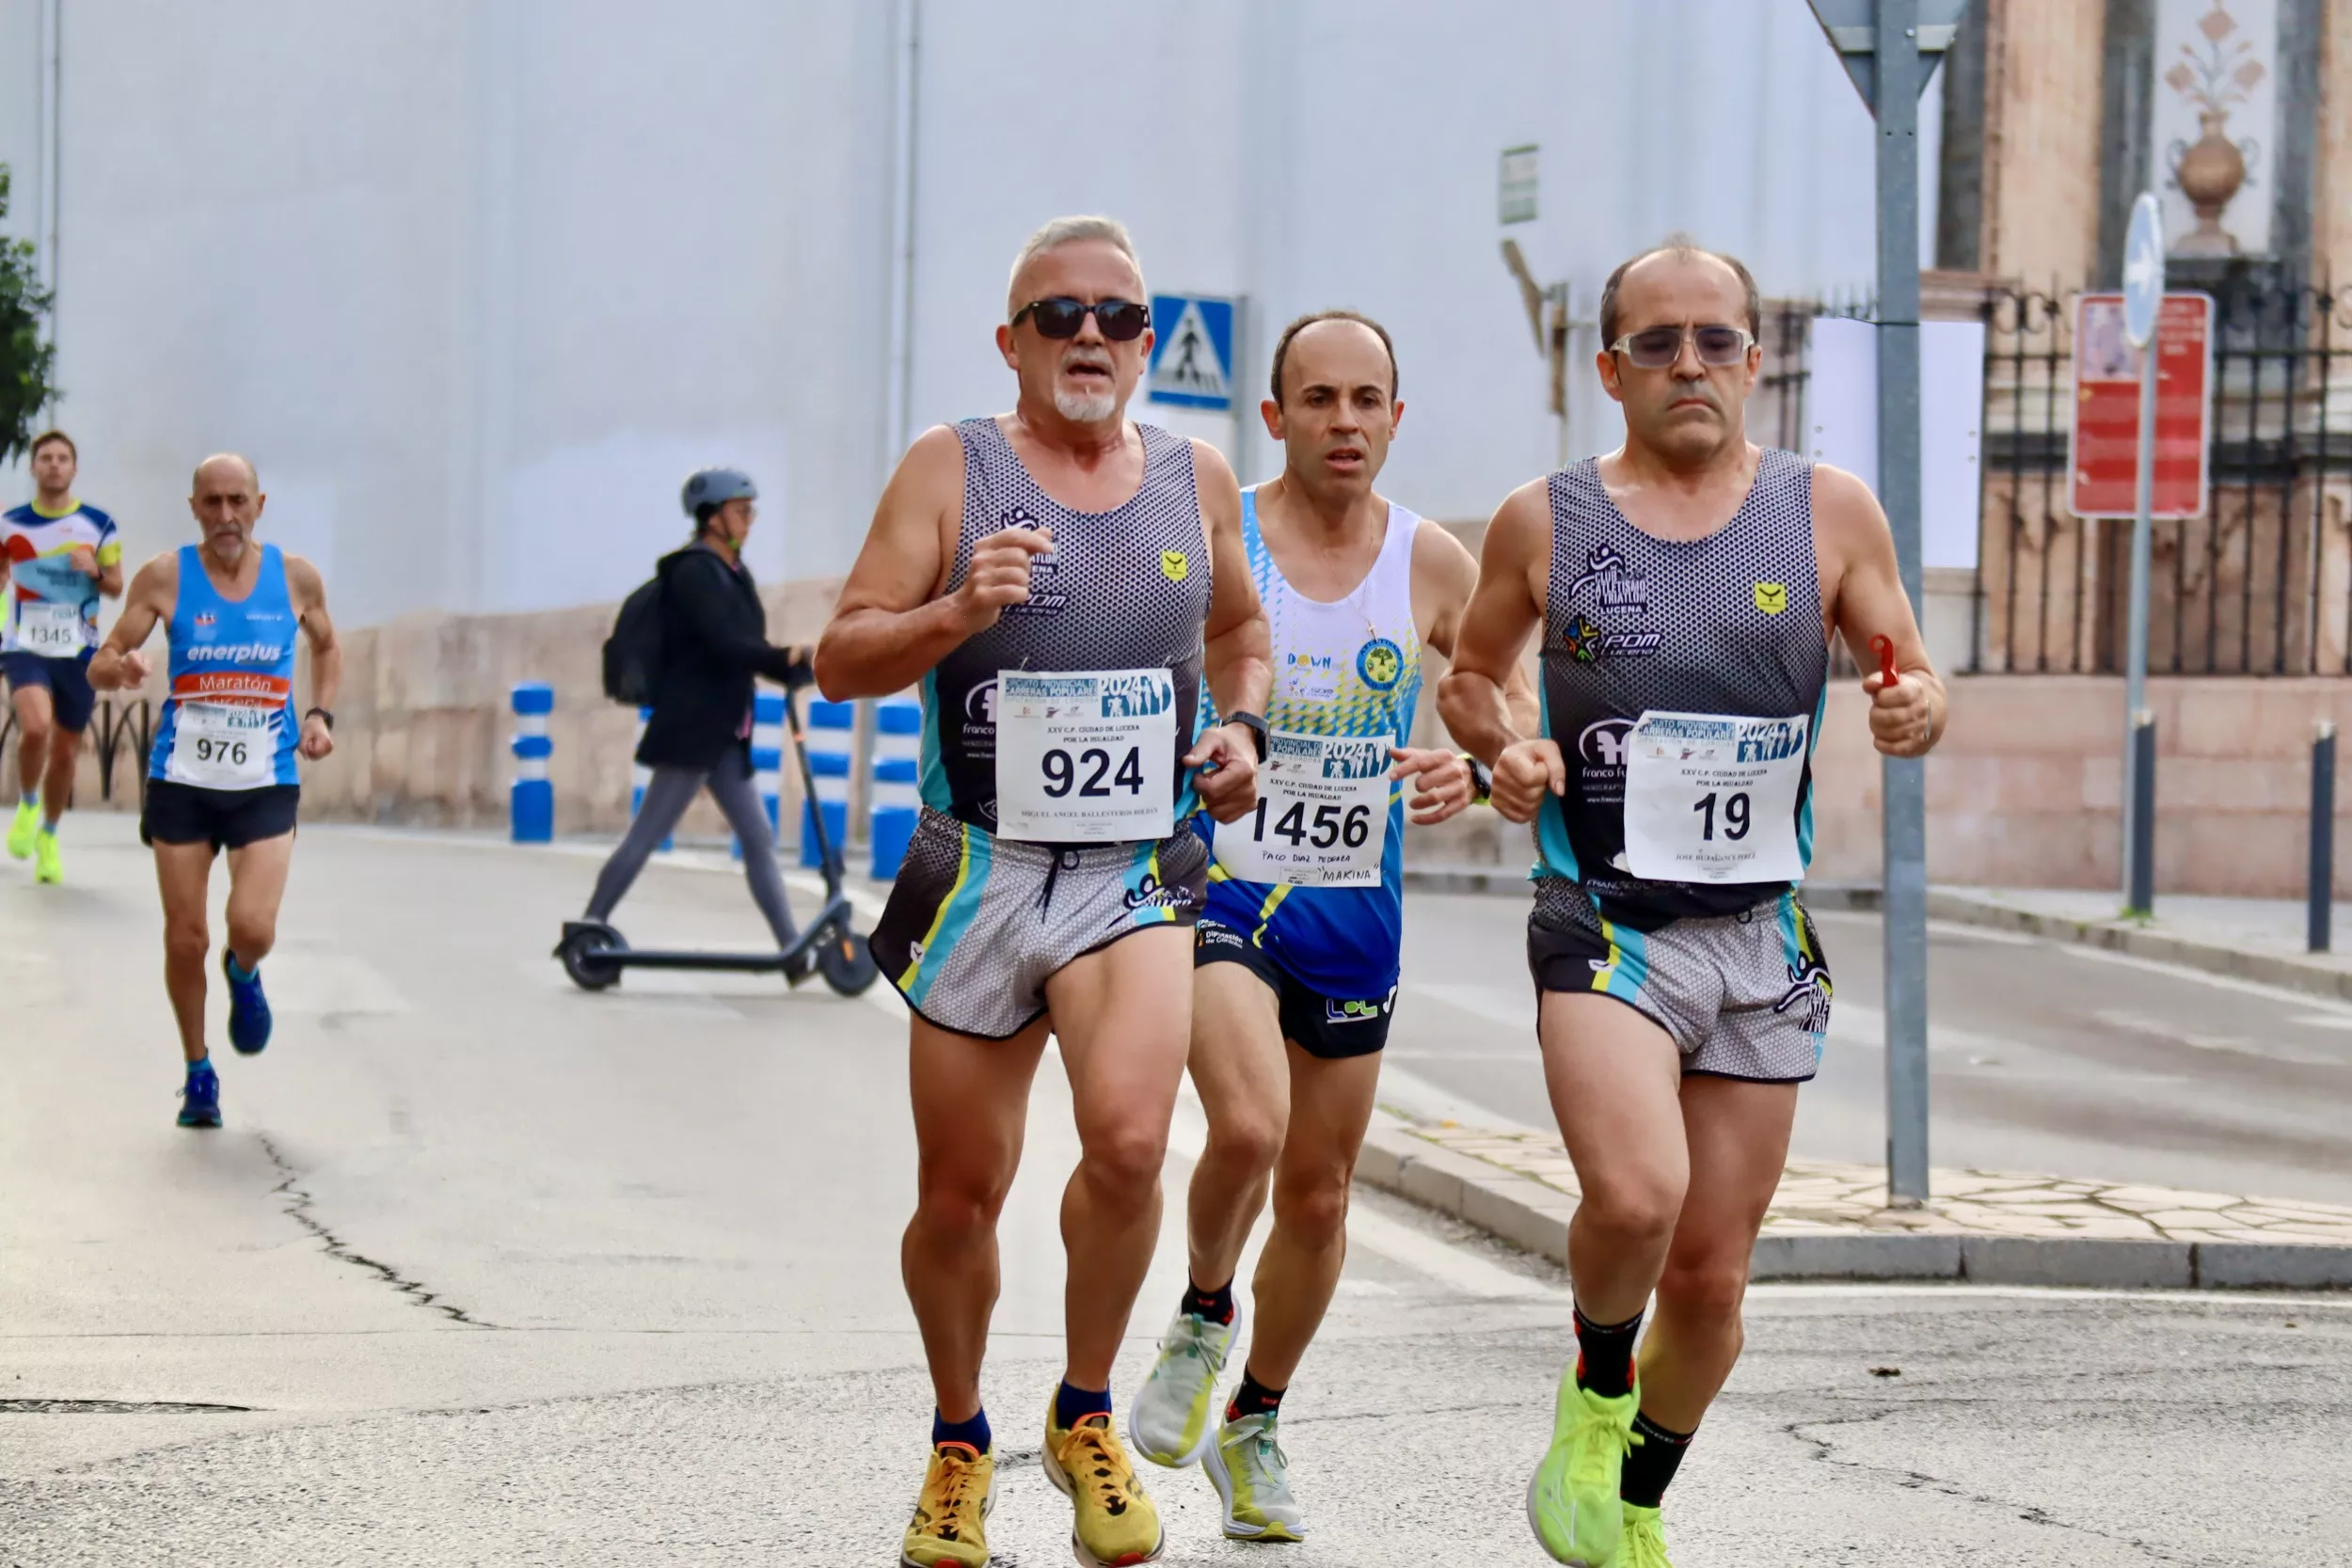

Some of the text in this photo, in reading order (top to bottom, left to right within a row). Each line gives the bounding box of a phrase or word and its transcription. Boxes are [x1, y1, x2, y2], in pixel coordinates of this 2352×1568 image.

[1025, 594, 1067, 607] DM
[1600, 606, 1643, 614] LUCENA
[30, 626, 72, 643] 1345
[1605, 633, 1661, 648] PDM
[187, 643, 280, 663] enerplus
[200, 674, 271, 692] Maratón
[1101, 676, 1144, 697] 2024
[1050, 688, 1099, 697] POPULARES
[1078, 725, 1104, 734] CIUDAD
[1677, 721, 1723, 731] PROVINCIAL
[1738, 722, 1780, 742] 2024
[1686, 729, 1736, 740] POPULARES
[197, 738, 246, 765] 976
[1277, 744, 1322, 758] POPULARES
[1324, 741, 1366, 761] 2024
[1041, 746, 1144, 798] 924
[1270, 778, 1284, 786] XXV
[1298, 782, 1323, 790] CIUDAD
[1253, 797, 1370, 848] 1456
[1693, 792, 1750, 841] 19
[1262, 850, 1287, 861] PACO
